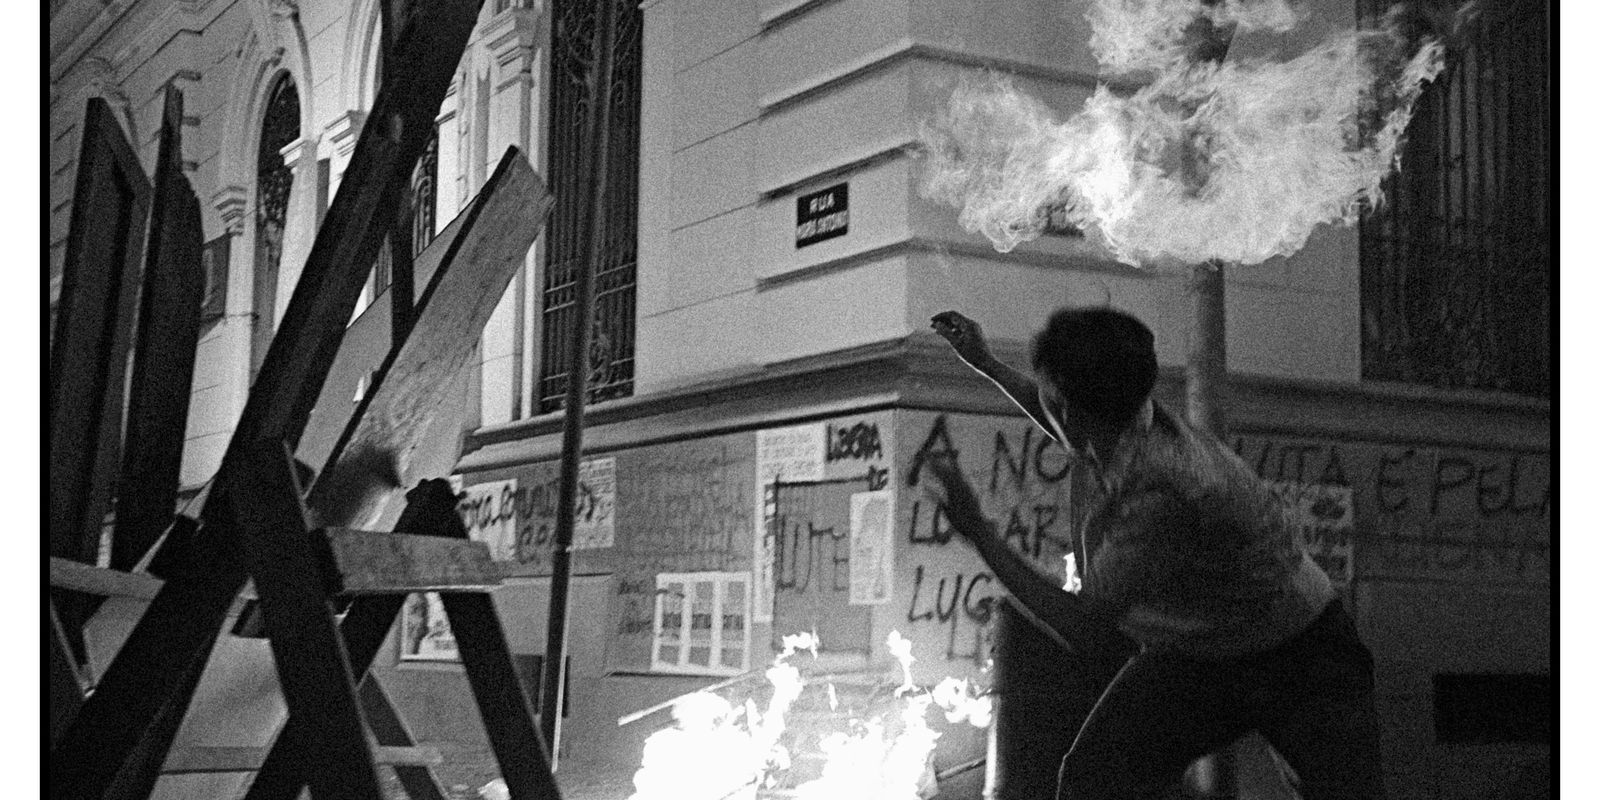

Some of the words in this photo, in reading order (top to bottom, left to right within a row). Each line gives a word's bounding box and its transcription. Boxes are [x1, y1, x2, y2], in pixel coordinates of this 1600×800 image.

[808, 192, 835, 214] RUA
[907, 414, 957, 487] A
[1377, 448, 1415, 513] É
